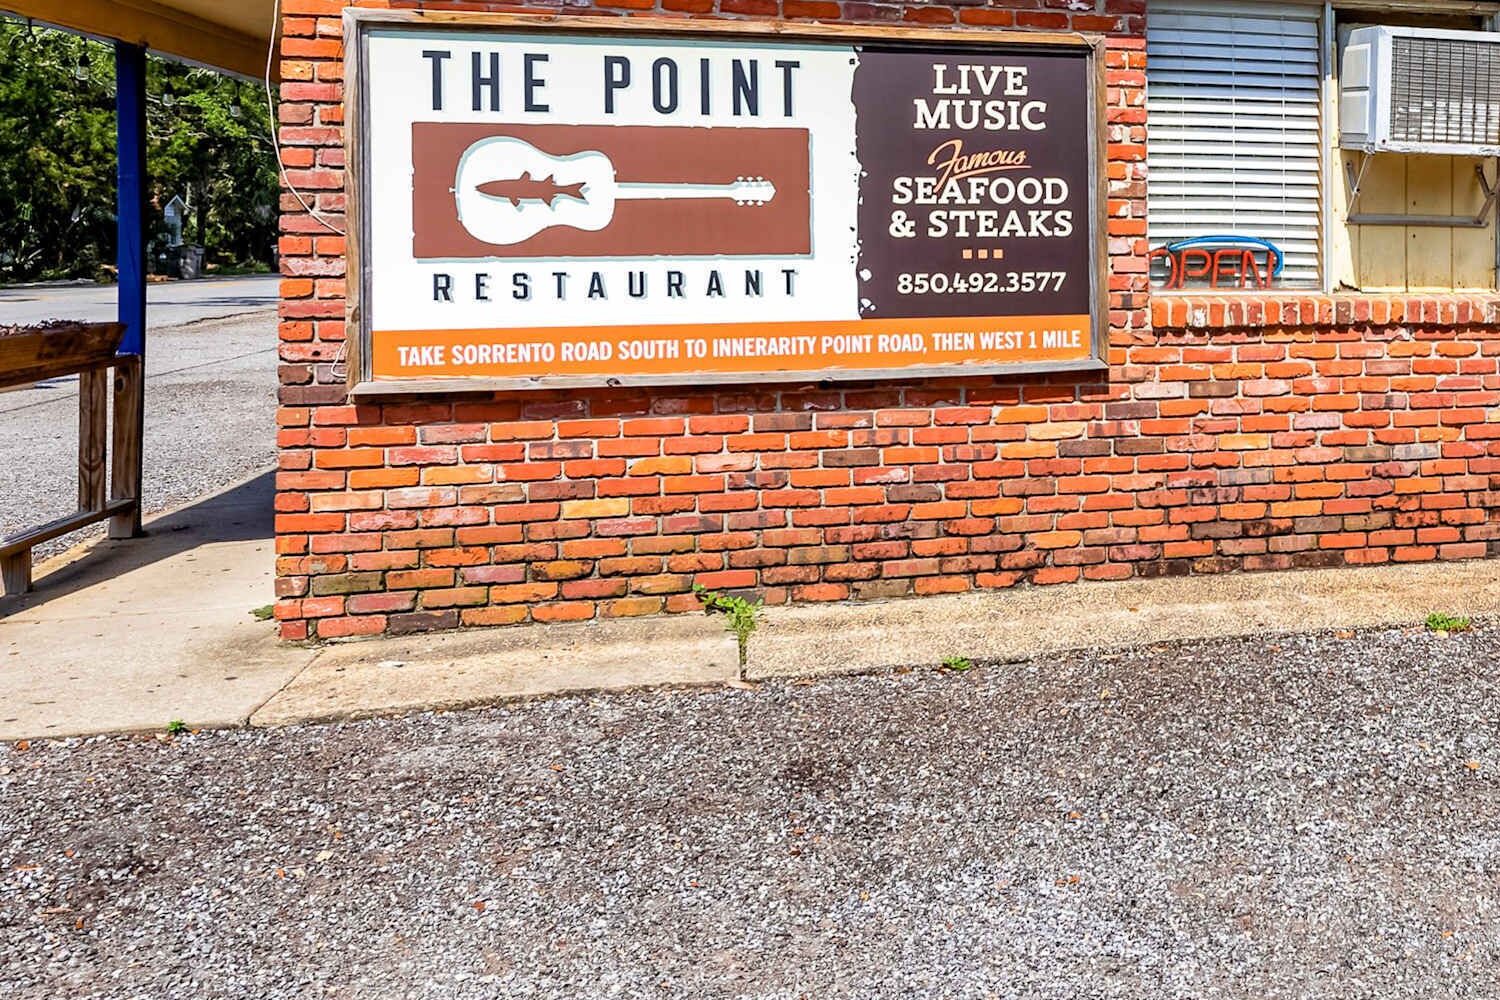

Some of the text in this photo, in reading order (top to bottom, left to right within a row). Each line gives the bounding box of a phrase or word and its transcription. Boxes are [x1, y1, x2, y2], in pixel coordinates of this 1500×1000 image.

[421, 49, 801, 118] THE POINT
[932, 64, 1029, 95] LIVE
[913, 99, 1047, 131] MUSIC
[927, 138, 1032, 193] Famous
[892, 177, 1069, 205] SEAFOOD
[889, 209, 1073, 238] & STEAKS
[897, 271, 1067, 294] 850.492.3577
[1148, 247, 1275, 290] OPEN
[432, 269, 798, 302] RESTAURANT
[397, 329, 1082, 366] TAKE SORRENTO ROAD SOUTH TO INNERARITY POINT ROAD, THEN WEST 1 MILE
